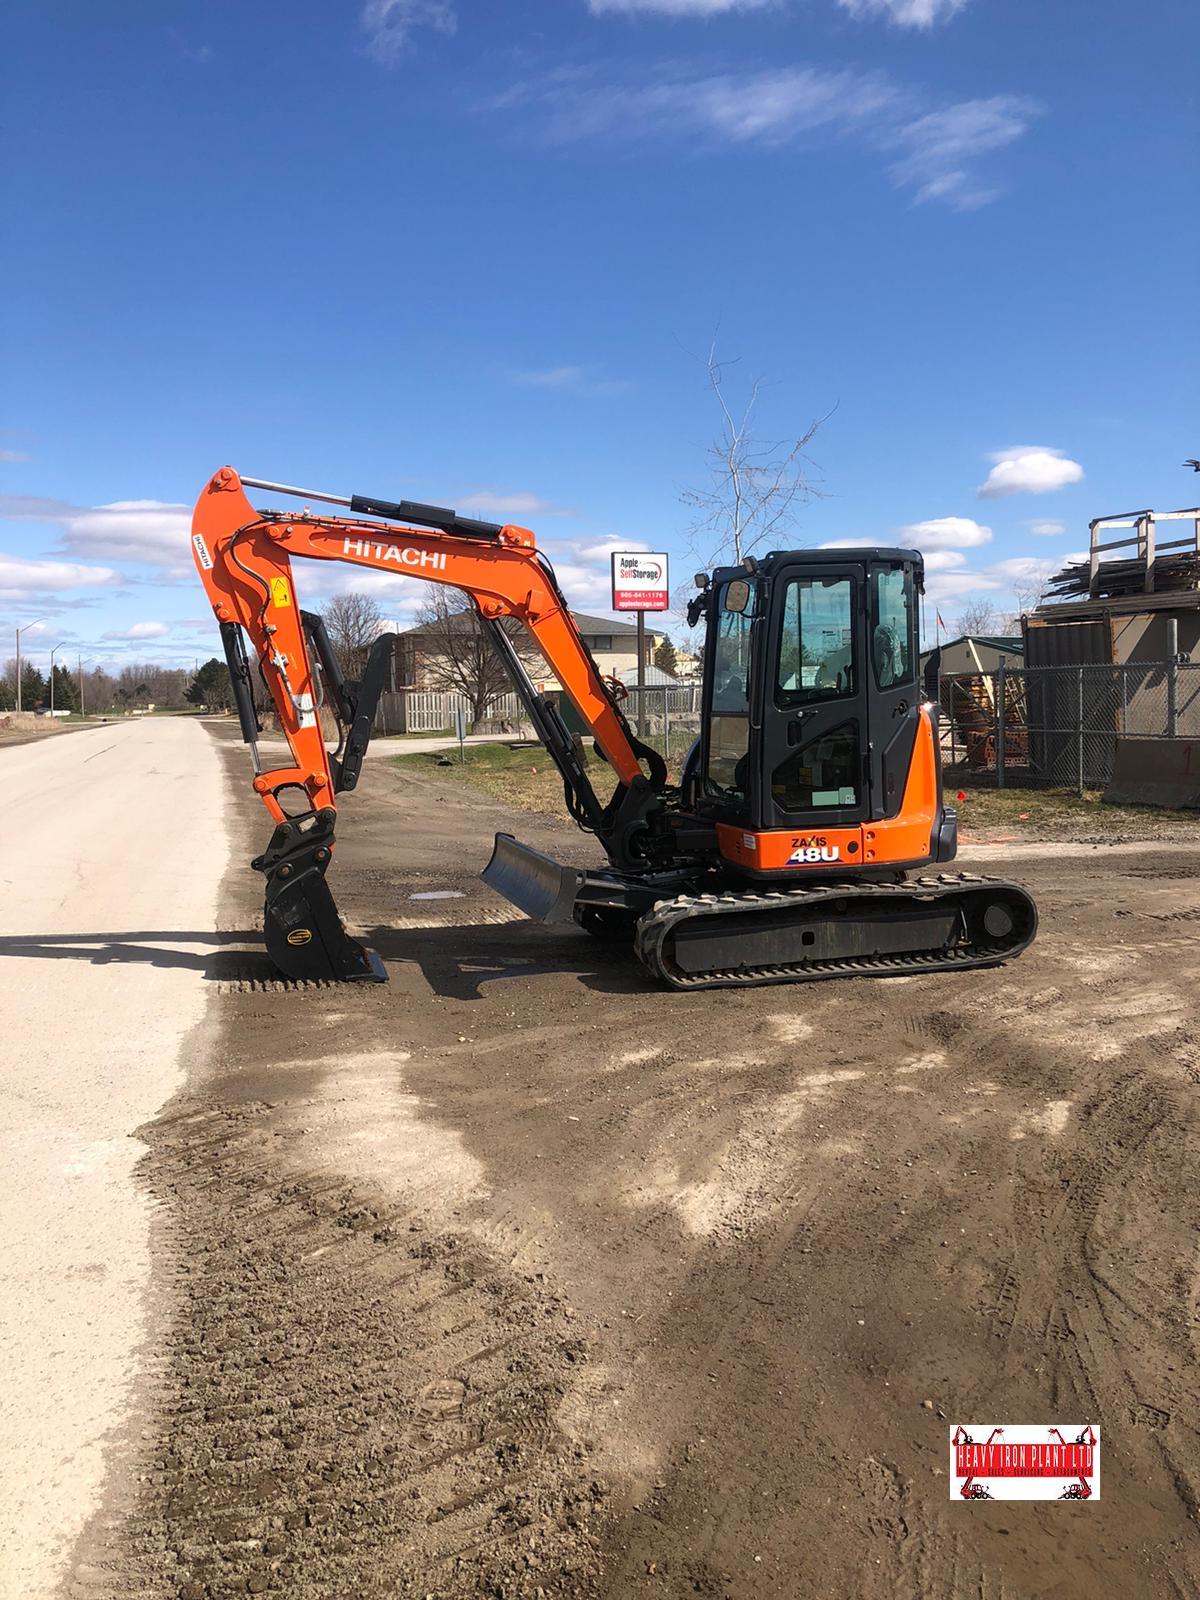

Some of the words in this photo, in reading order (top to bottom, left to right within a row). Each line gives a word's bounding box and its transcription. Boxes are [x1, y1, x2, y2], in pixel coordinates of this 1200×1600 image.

[194, 536, 211, 567] HITACHI
[343, 537, 446, 570] HITACHI
[620, 558, 638, 568] Apple
[791, 835, 827, 847] ZAXIS
[790, 847, 839, 863] 48U
